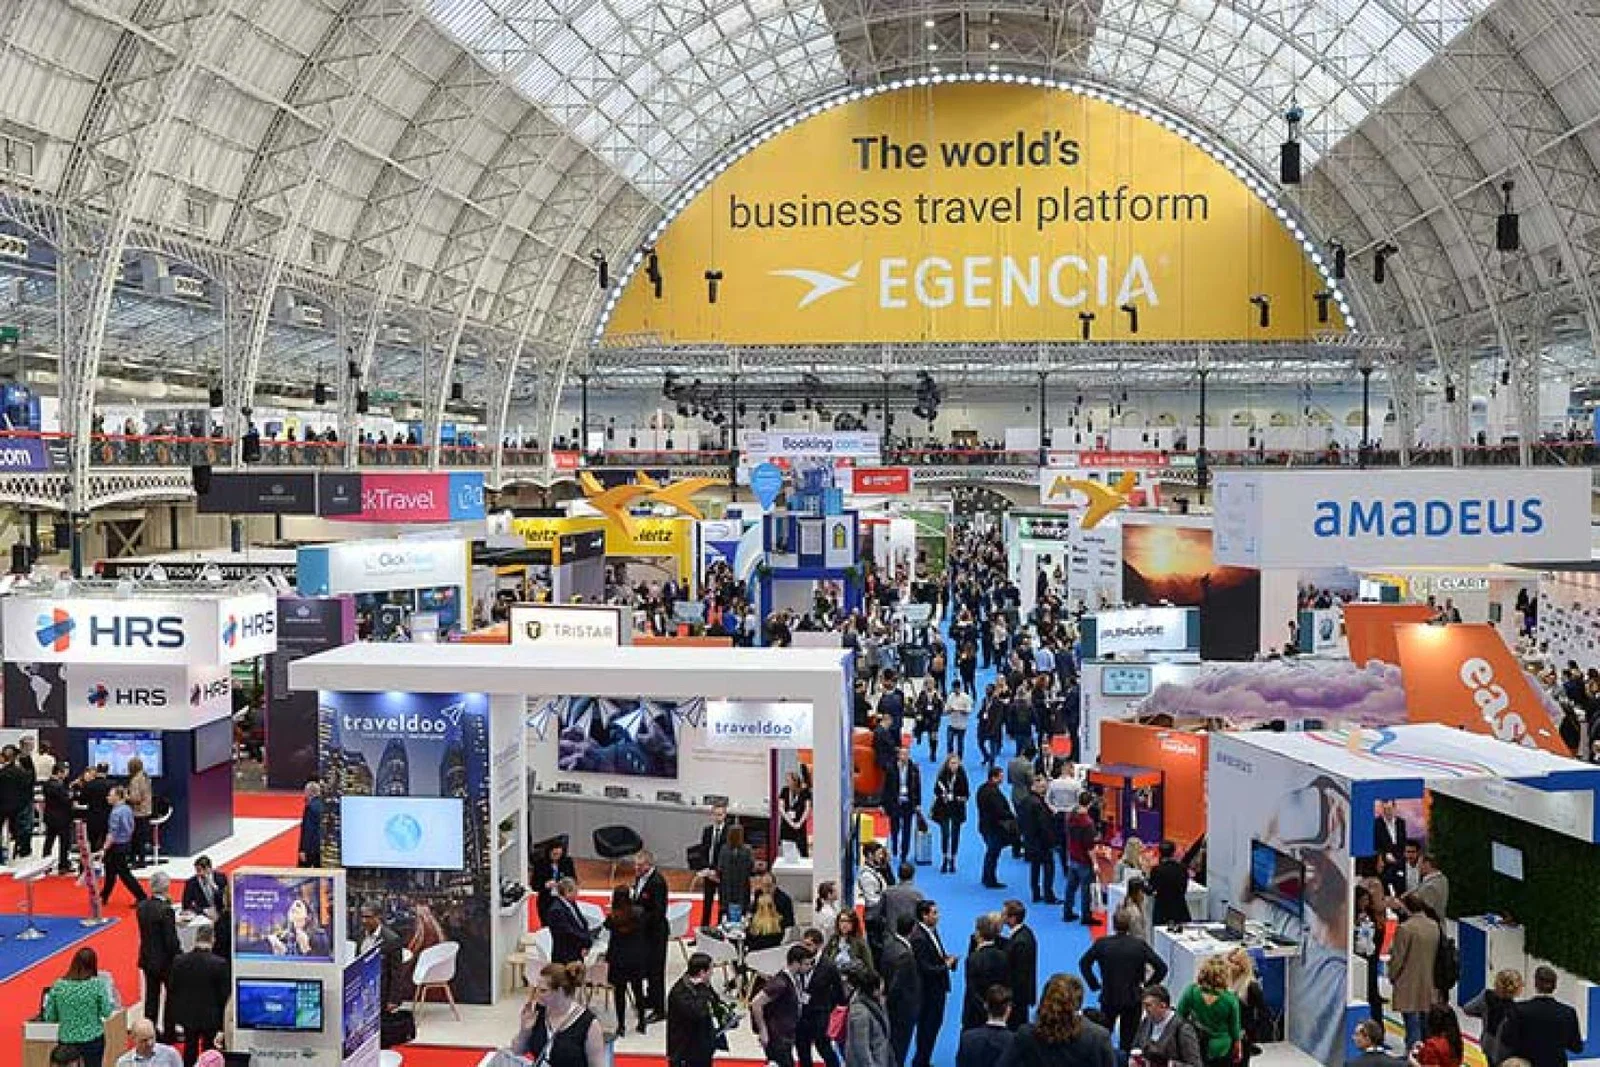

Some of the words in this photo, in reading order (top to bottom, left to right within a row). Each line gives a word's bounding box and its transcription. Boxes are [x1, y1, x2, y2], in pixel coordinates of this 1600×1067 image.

[852, 135, 928, 171] The
[942, 131, 1080, 169] world's
[729, 194, 902, 229] business
[914, 187, 1022, 225] travel
[1037, 186, 1209, 231] platform
[879, 254, 1159, 309] EGENCIA
[90, 616, 185, 648] HRS
[242, 611, 275, 638] HRS
[115, 689, 168, 707] HRS
[203, 678, 229, 700] HRS
[343, 714, 447, 734] traveldoo
[715, 720, 792, 735] traveldoo
